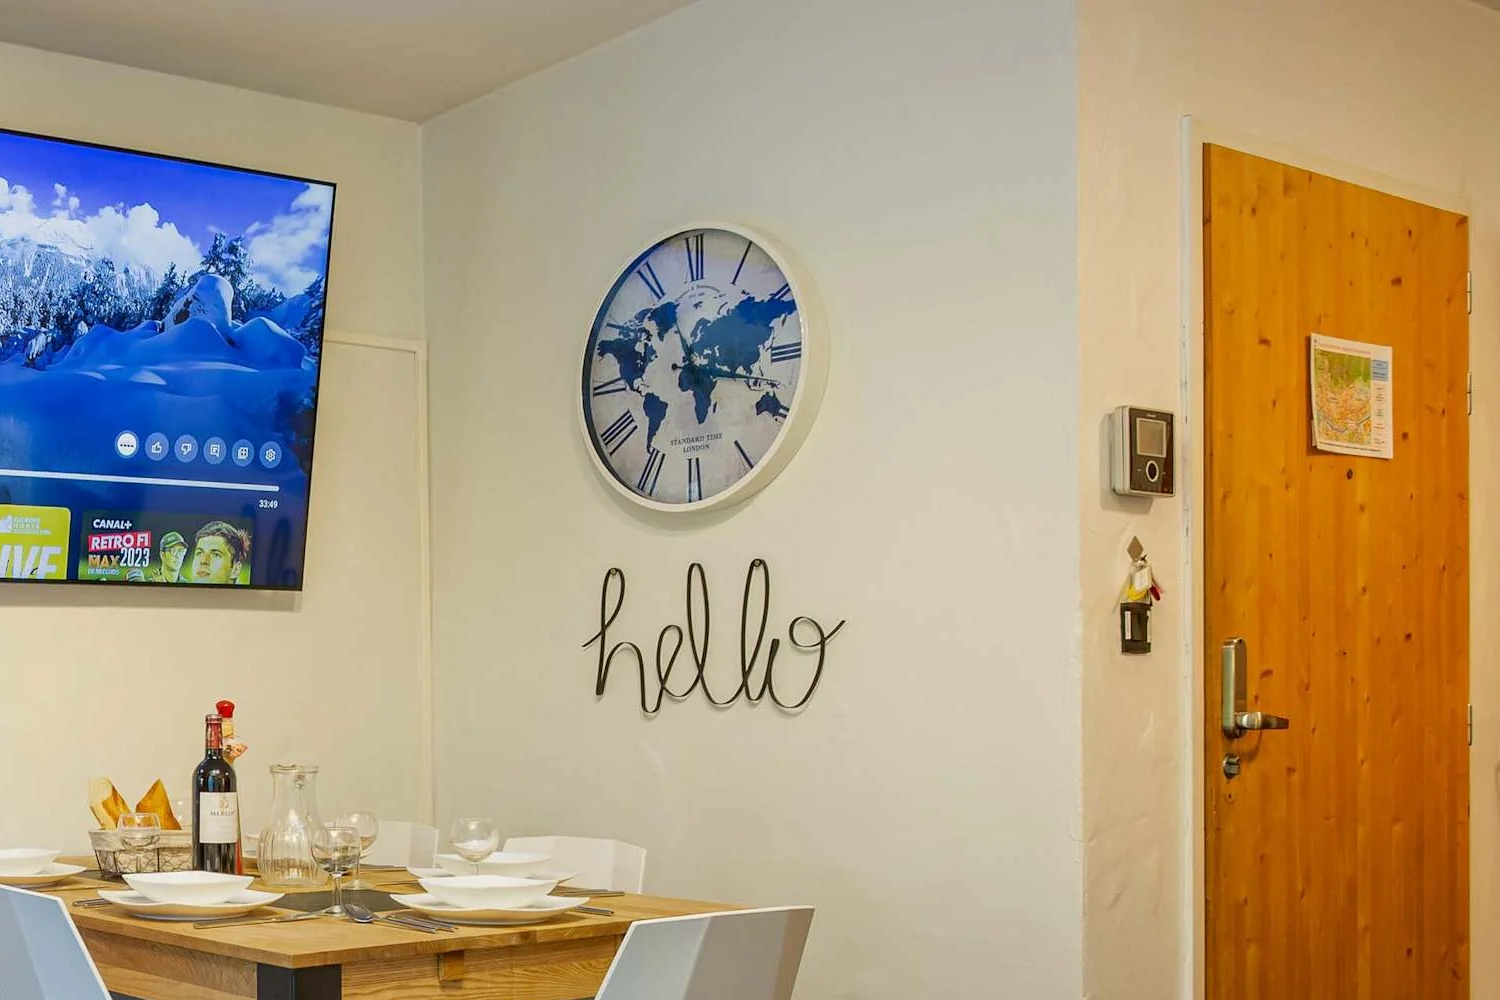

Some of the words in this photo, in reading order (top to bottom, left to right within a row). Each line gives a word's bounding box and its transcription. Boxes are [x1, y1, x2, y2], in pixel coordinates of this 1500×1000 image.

[683, 444, 710, 453] LONDON
[93, 518, 133, 530] CANAL+
[91, 533, 135, 551] RETRO
[137, 532, 150, 547] F1
[120, 547, 150, 567] 2023
[581, 558, 846, 714] hello
